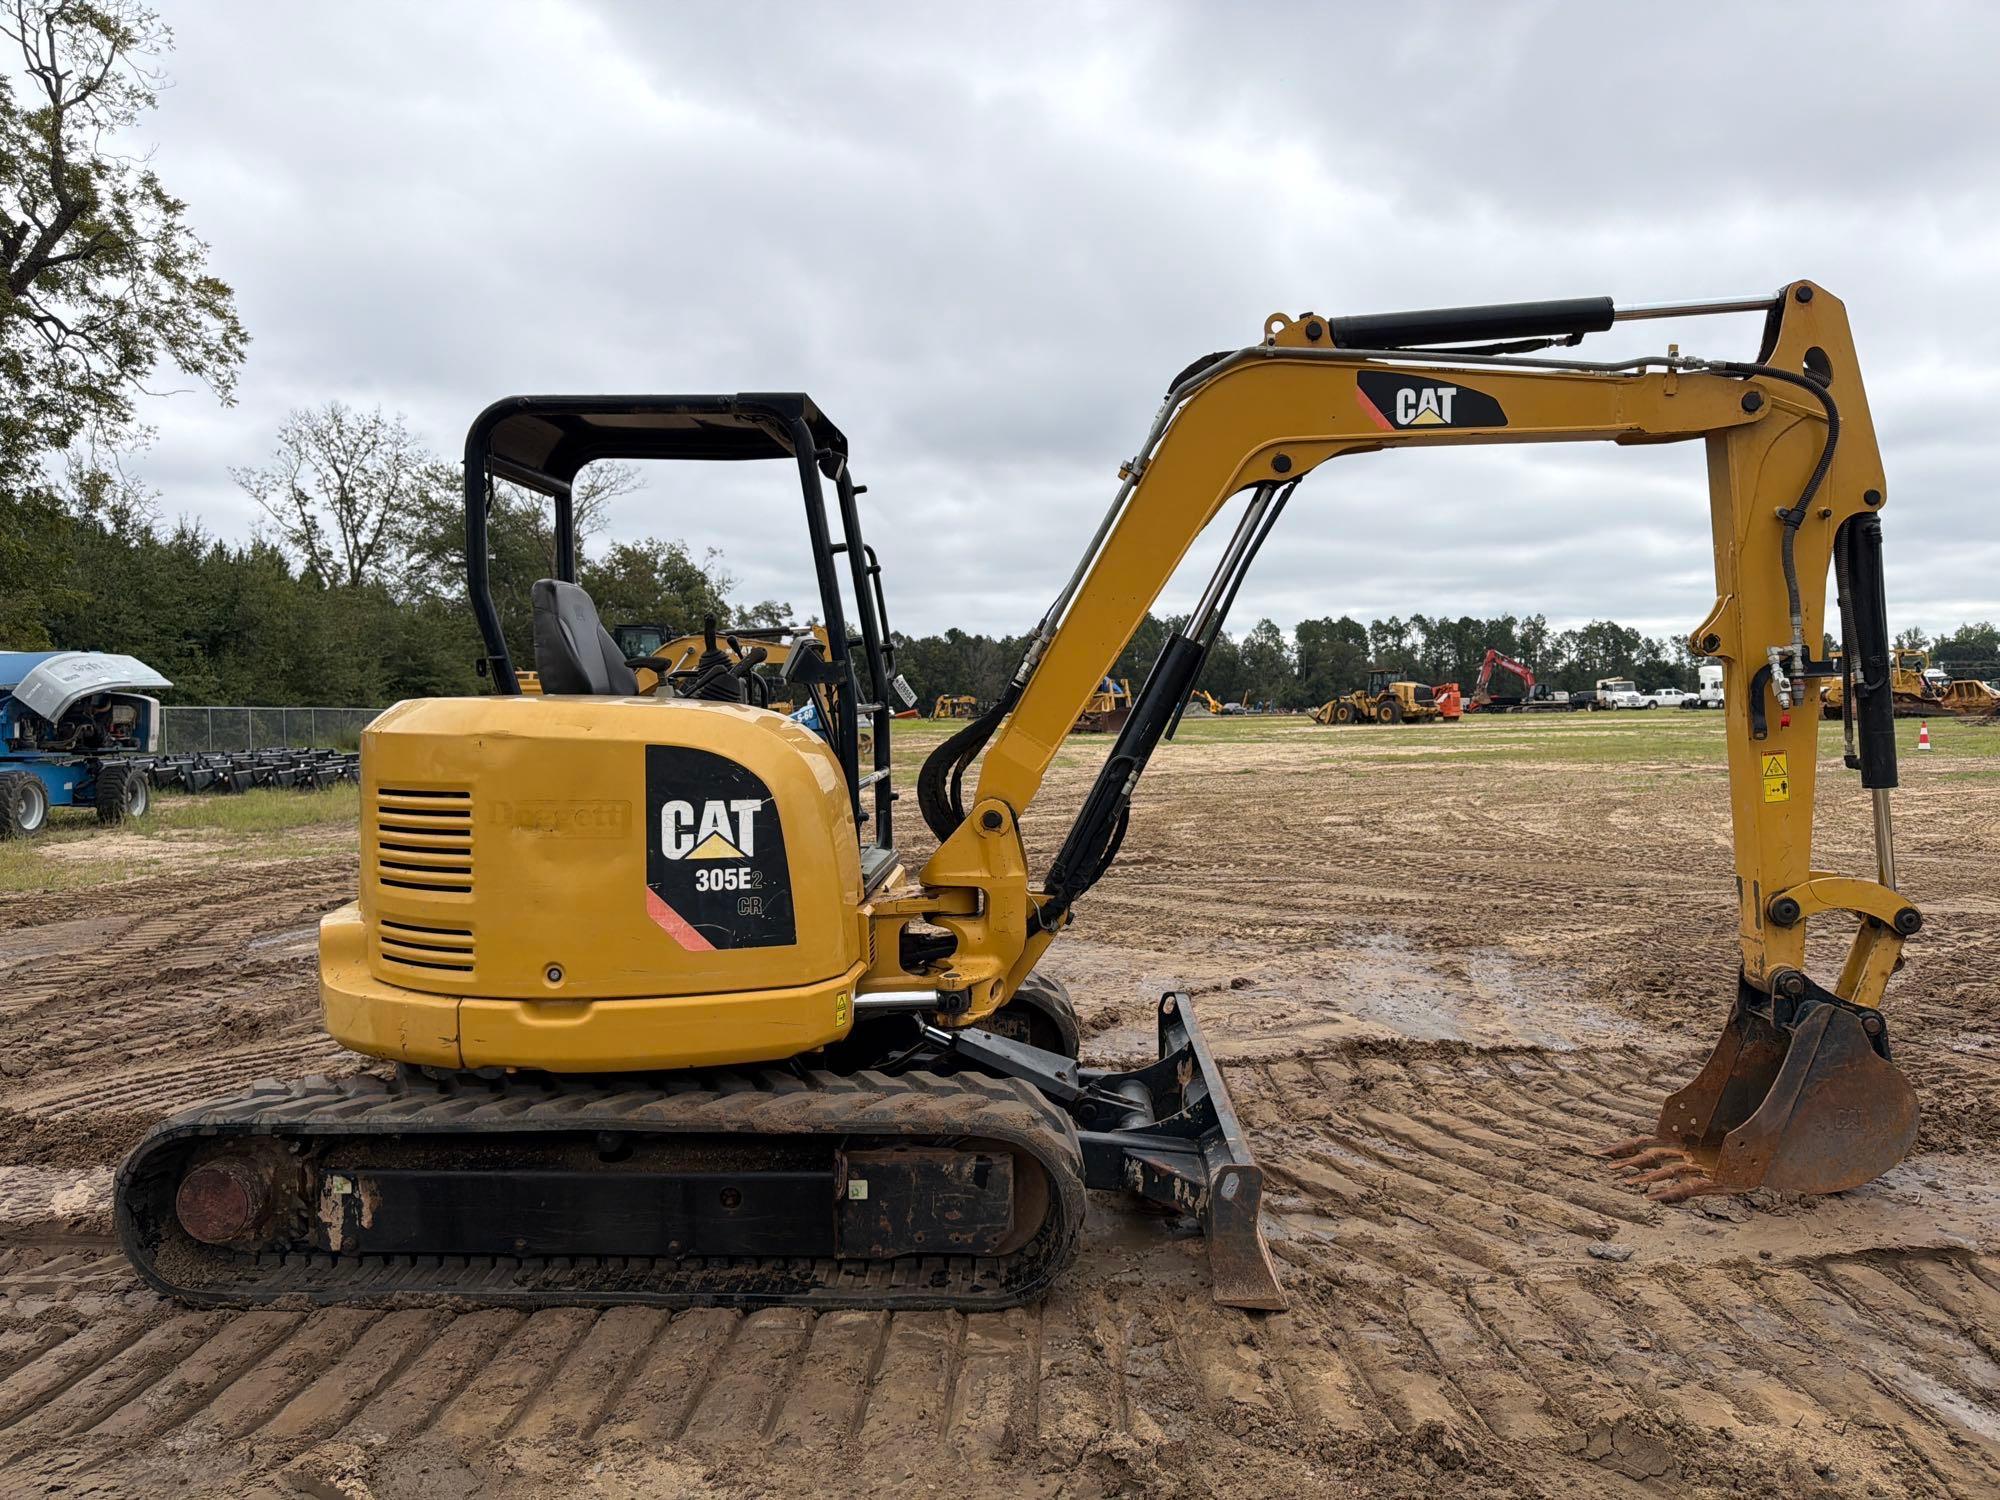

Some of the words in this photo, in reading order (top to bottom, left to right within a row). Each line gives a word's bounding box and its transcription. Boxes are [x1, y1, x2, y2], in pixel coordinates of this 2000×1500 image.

[1396, 387, 1457, 425] CAT
[797, 709, 814, 723] S-60
[661, 799, 762, 861] CAT
[695, 867, 763, 892] 305E2
[737, 896, 763, 916] CR
